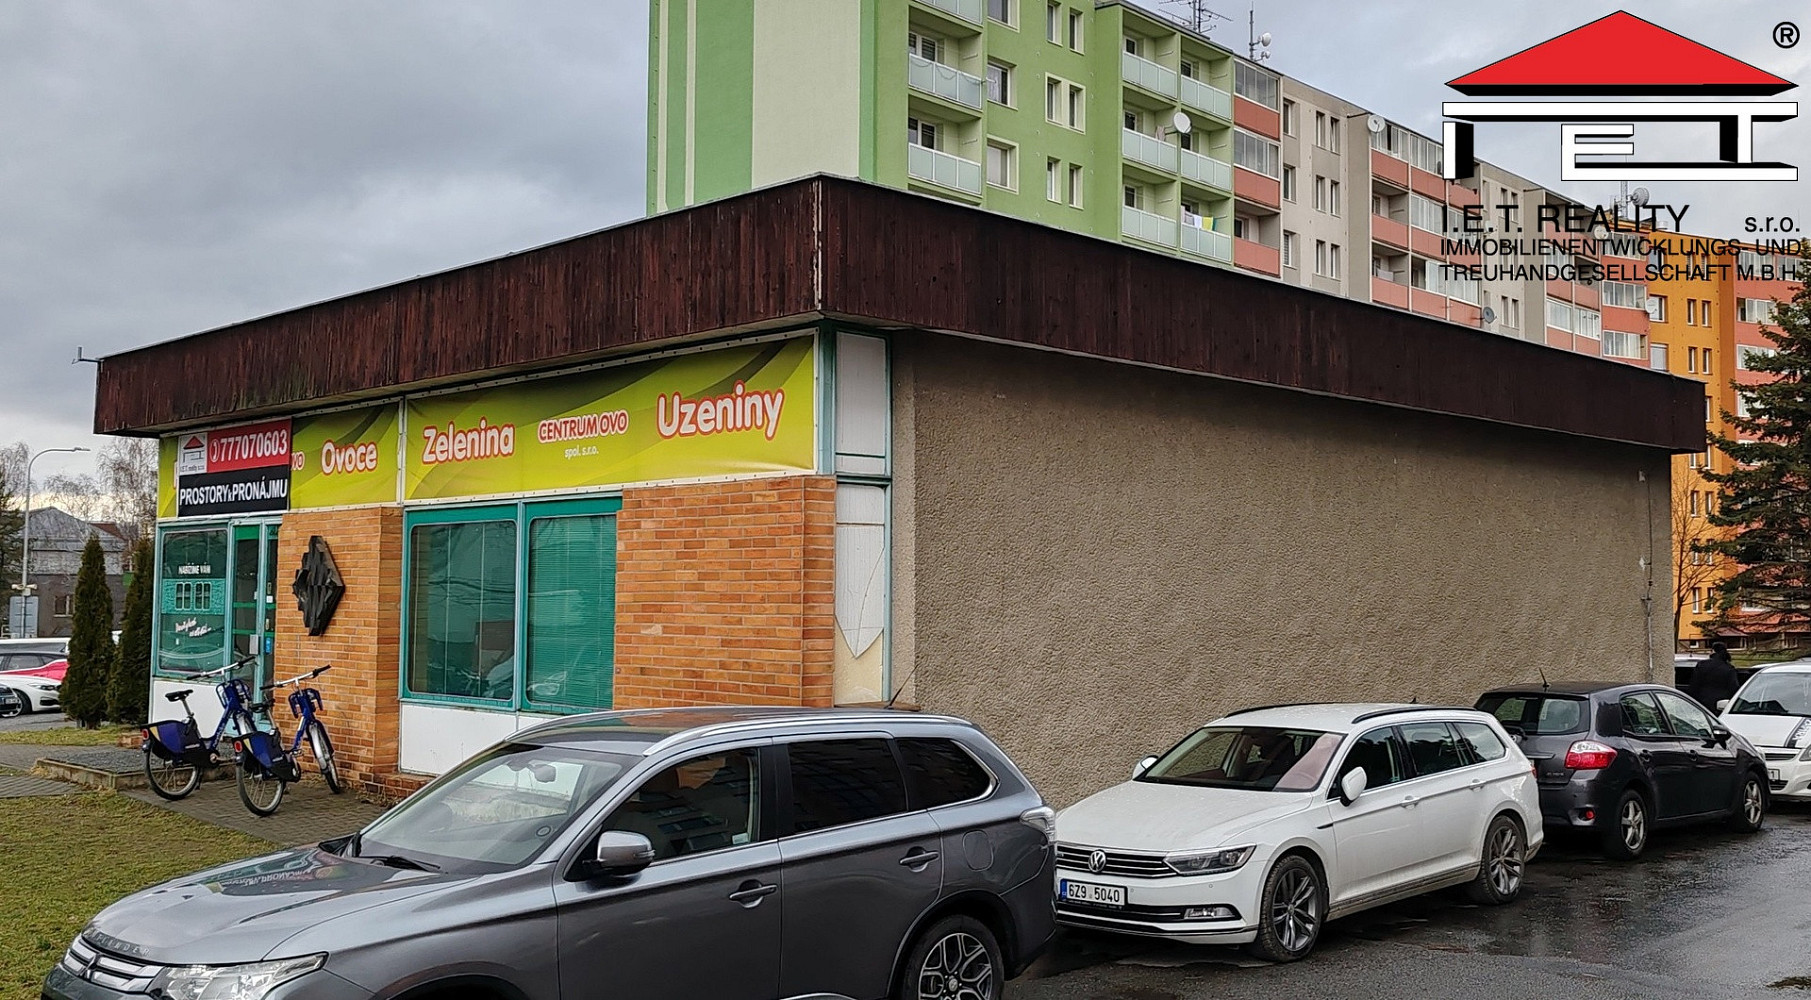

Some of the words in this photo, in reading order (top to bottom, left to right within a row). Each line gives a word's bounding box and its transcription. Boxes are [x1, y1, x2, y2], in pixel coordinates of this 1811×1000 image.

[537, 414, 599, 444] CENTRUM
[599, 410, 629, 437] OVO
[657, 380, 785, 441] Uzeniny
[220, 429, 288, 462] 777070603
[321, 439, 378, 476] Ovoce
[422, 417, 515, 465] Zelenina
[564, 446, 581, 460] spol.
[581, 447, 599, 456] s.r.o.
[180, 484, 229, 506] PROSTORY
[232, 475, 288, 501] PRONÁJMU
[1069, 884, 1087, 899] 6Z9
[1094, 887, 1120, 902] 5040
